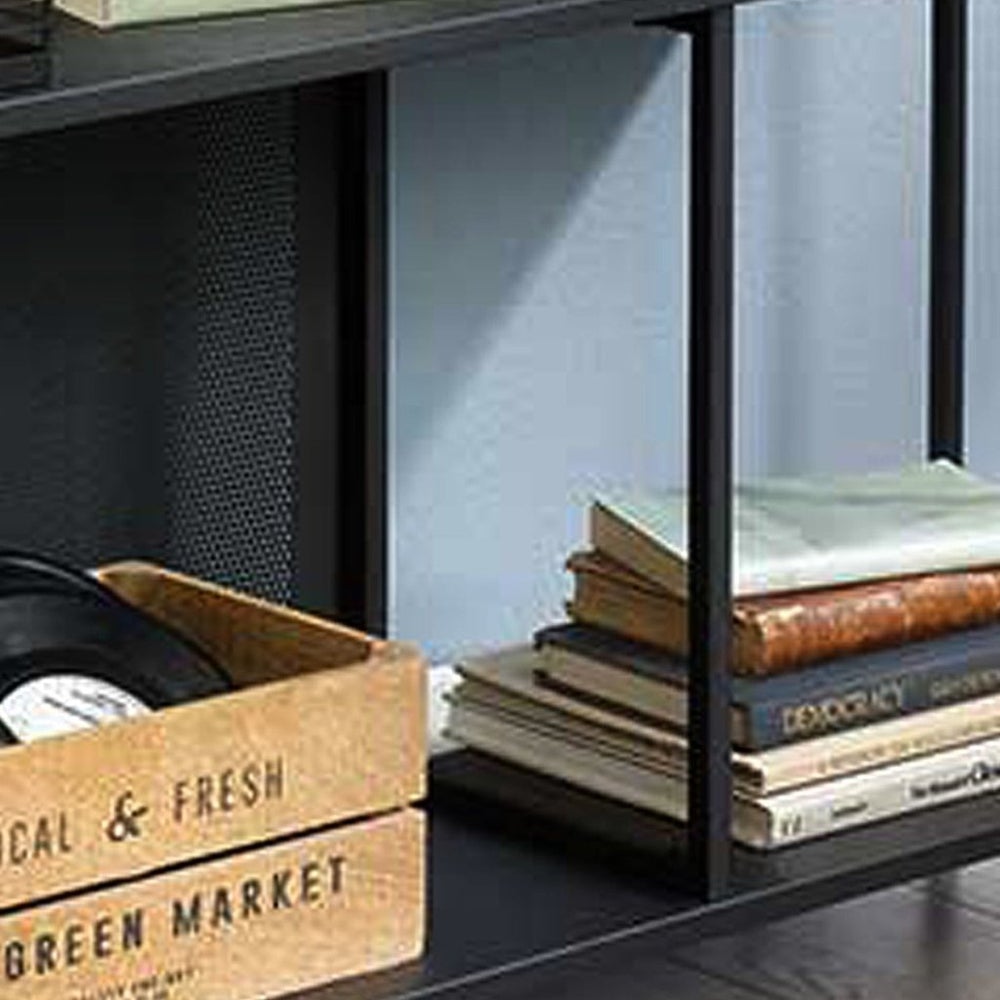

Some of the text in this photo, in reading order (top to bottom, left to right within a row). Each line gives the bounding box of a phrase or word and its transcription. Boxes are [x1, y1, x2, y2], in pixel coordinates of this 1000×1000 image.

[0, 756, 284, 866] CAL & FRESH
[4, 856, 348, 981] GREEN MARKET
